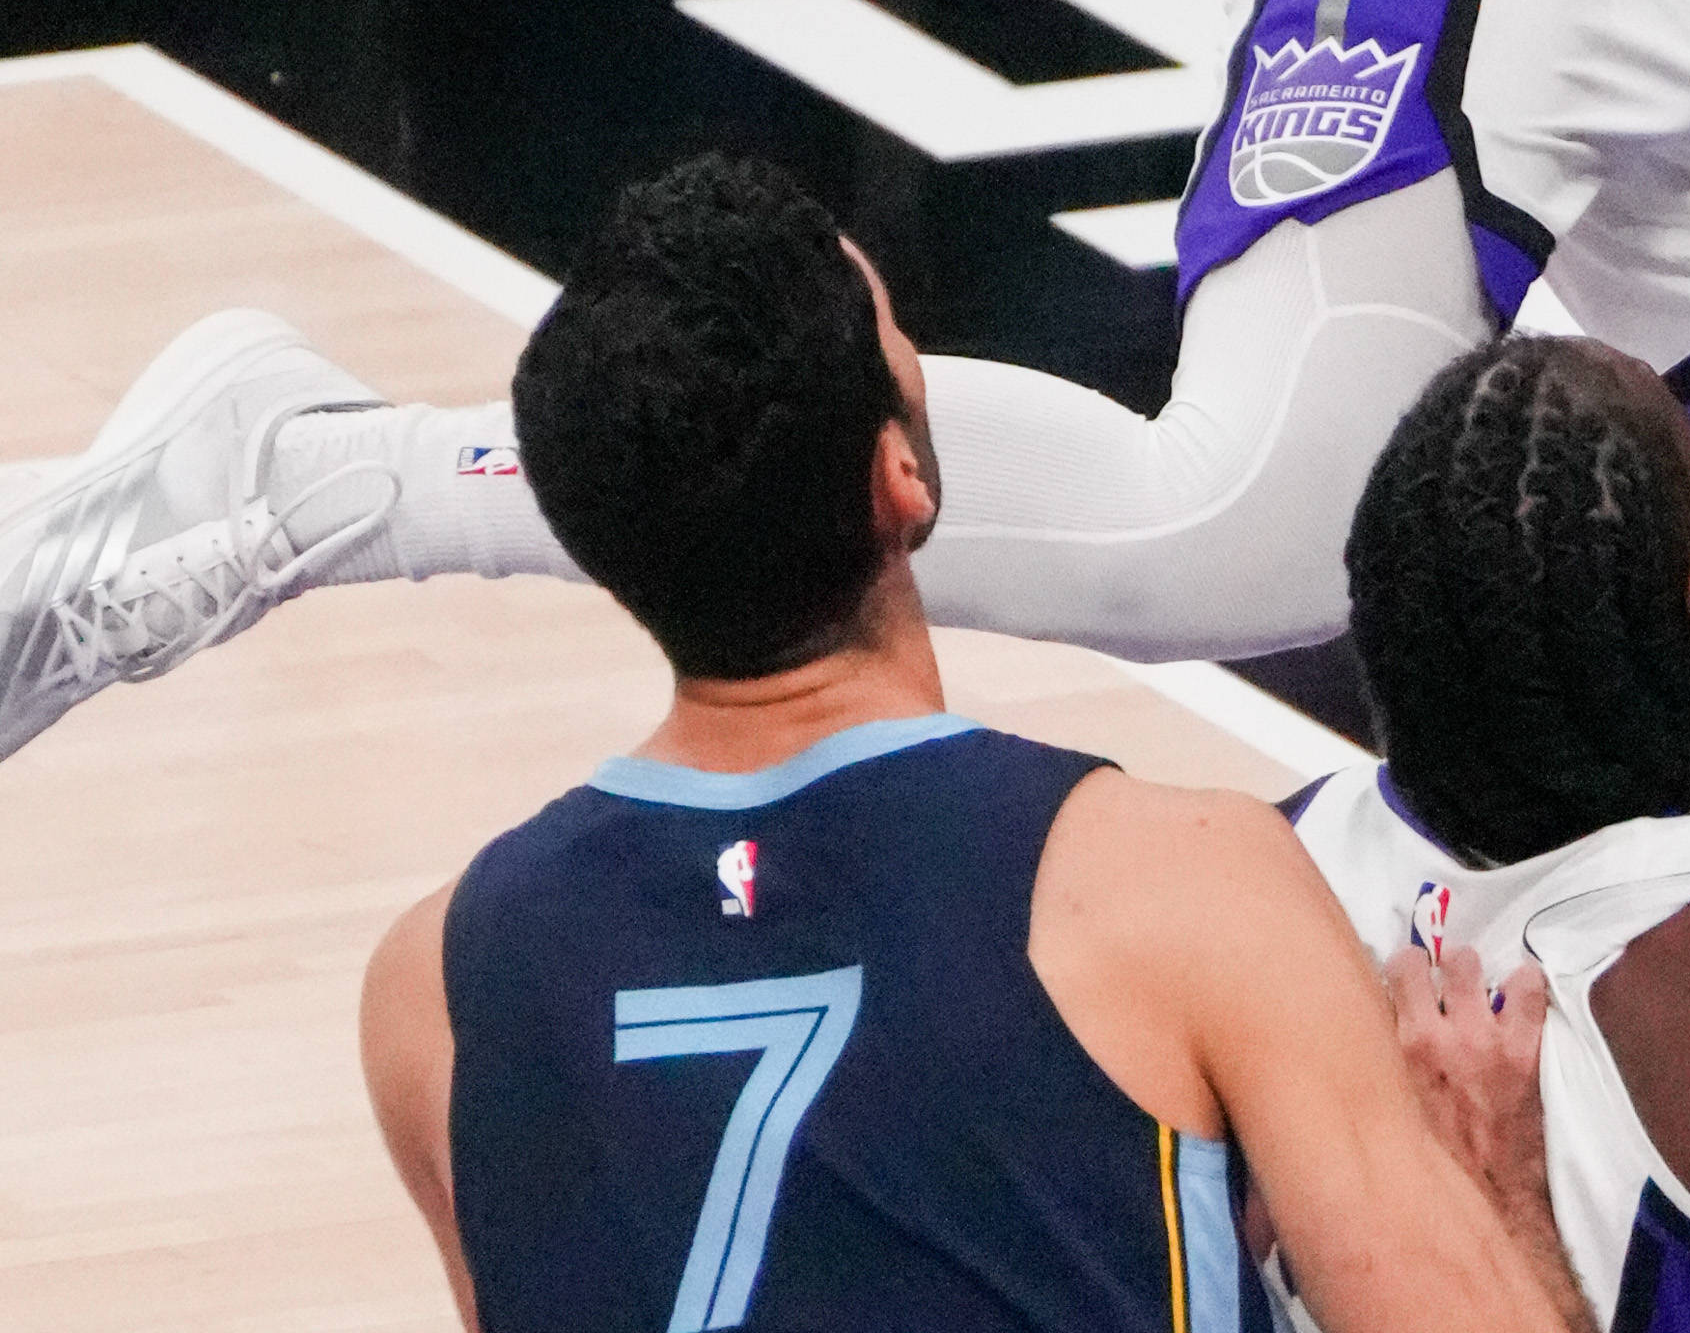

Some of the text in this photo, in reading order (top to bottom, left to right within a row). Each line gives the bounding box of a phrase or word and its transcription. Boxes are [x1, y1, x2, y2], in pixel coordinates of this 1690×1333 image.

[1251, 83, 1388, 107] SACRAMENTO
[1235, 106, 1384, 154] KINGS
[613, 964, 864, 1333] 7
